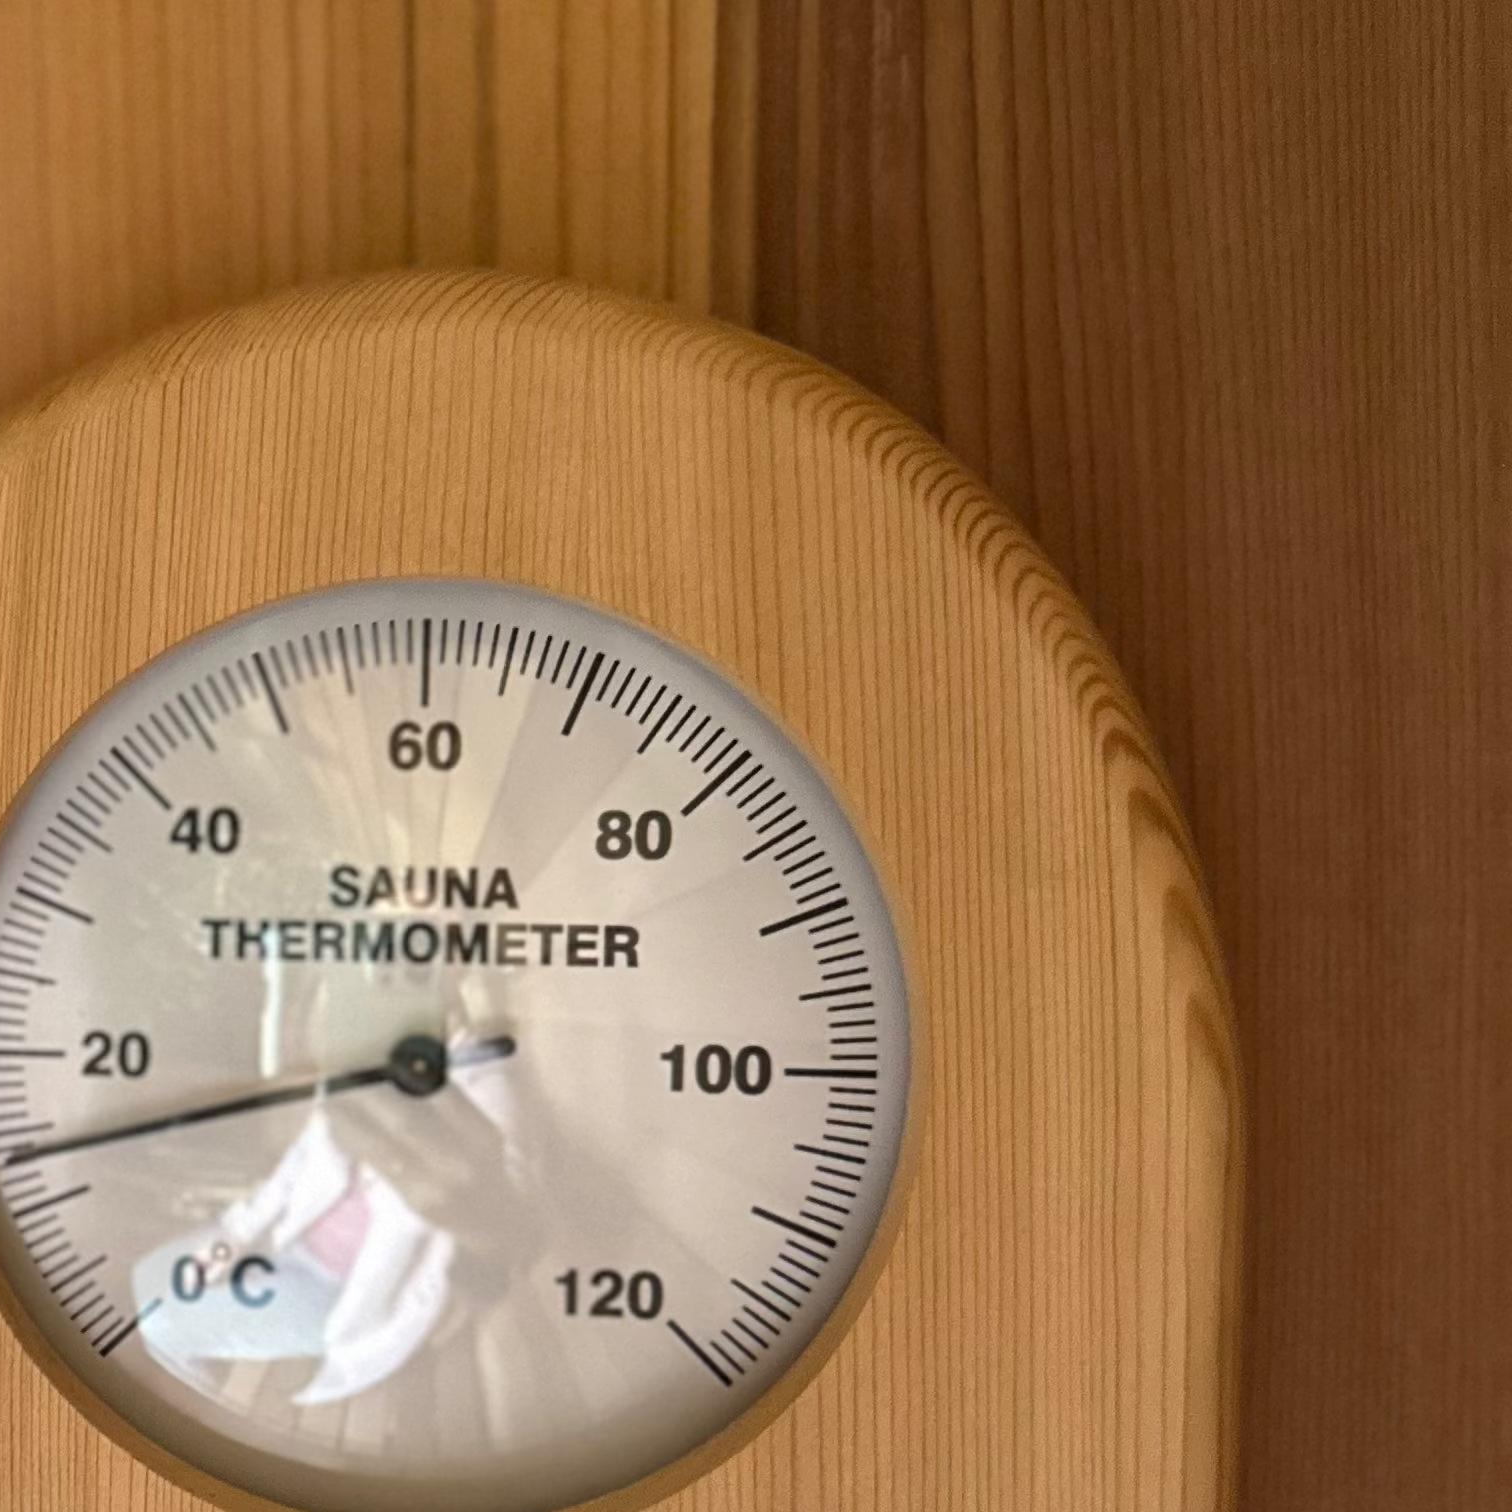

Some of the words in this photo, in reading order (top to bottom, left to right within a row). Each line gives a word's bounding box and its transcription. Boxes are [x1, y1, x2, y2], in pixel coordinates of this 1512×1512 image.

[388, 721, 462, 771] 60
[170, 807, 240, 853] 40
[596, 810, 673, 860] 80
[329, 866, 519, 909] SAUNA
[201, 919, 640, 968] THERMOMETER
[82, 1032, 151, 1079] 20
[660, 1045, 773, 1095] 100
[555, 1269, 664, 1320] 120
